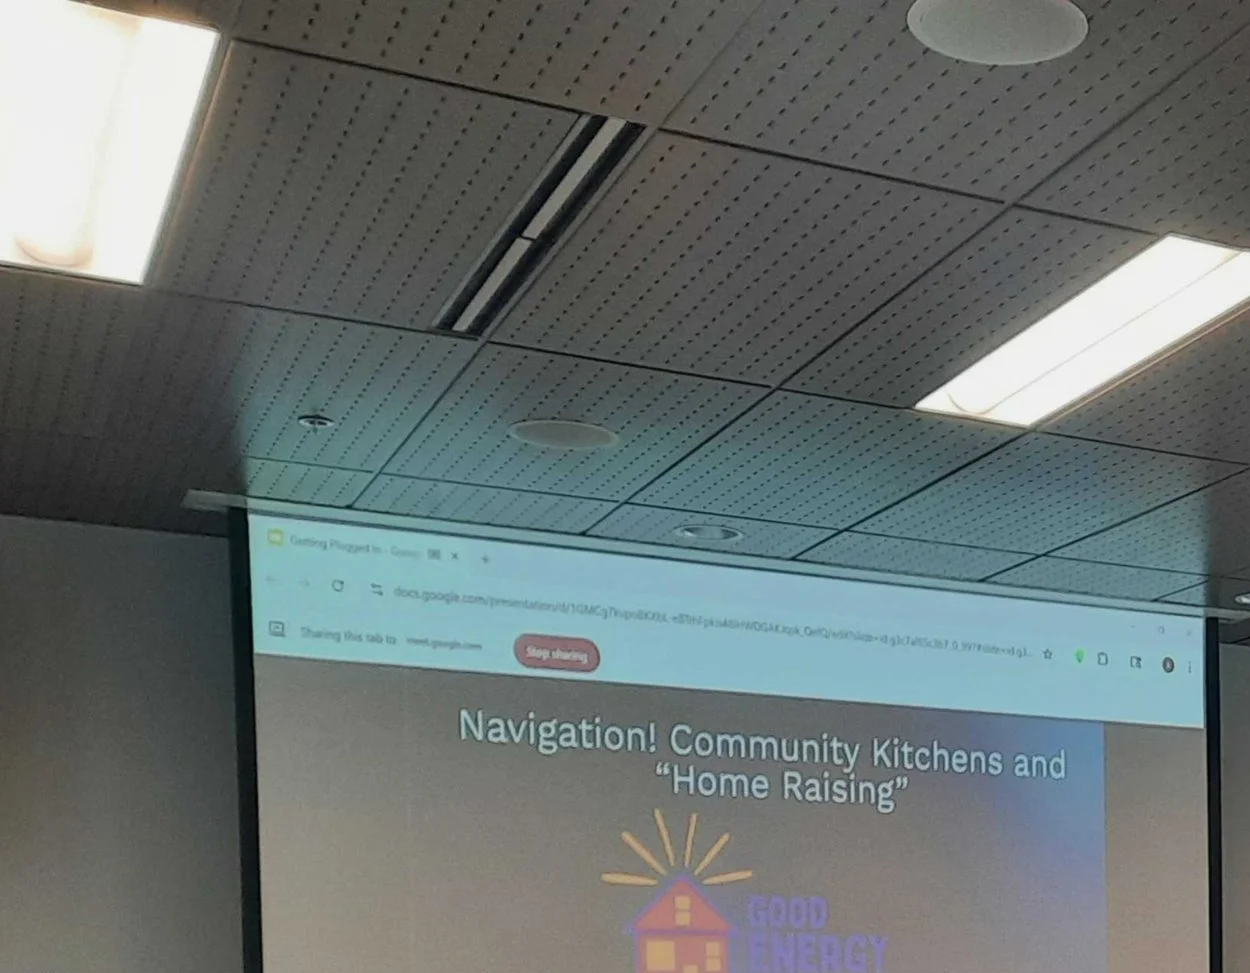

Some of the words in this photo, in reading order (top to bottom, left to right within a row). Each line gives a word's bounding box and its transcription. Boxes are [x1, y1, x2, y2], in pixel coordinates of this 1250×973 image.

[300, 625, 341, 644] Sharing
[344, 628, 364, 643] this
[366, 630, 384, 645] tab
[385, 632, 397, 646] to
[525, 644, 551, 661] Stop
[552, 647, 589, 665] sharing
[458, 708, 657, 754] Navigation!
[670, 724, 861, 772] Community
[872, 738, 1003, 776] Kitchens
[1013, 749, 1067, 780] and
[747, 894, 829, 929] GOOD
